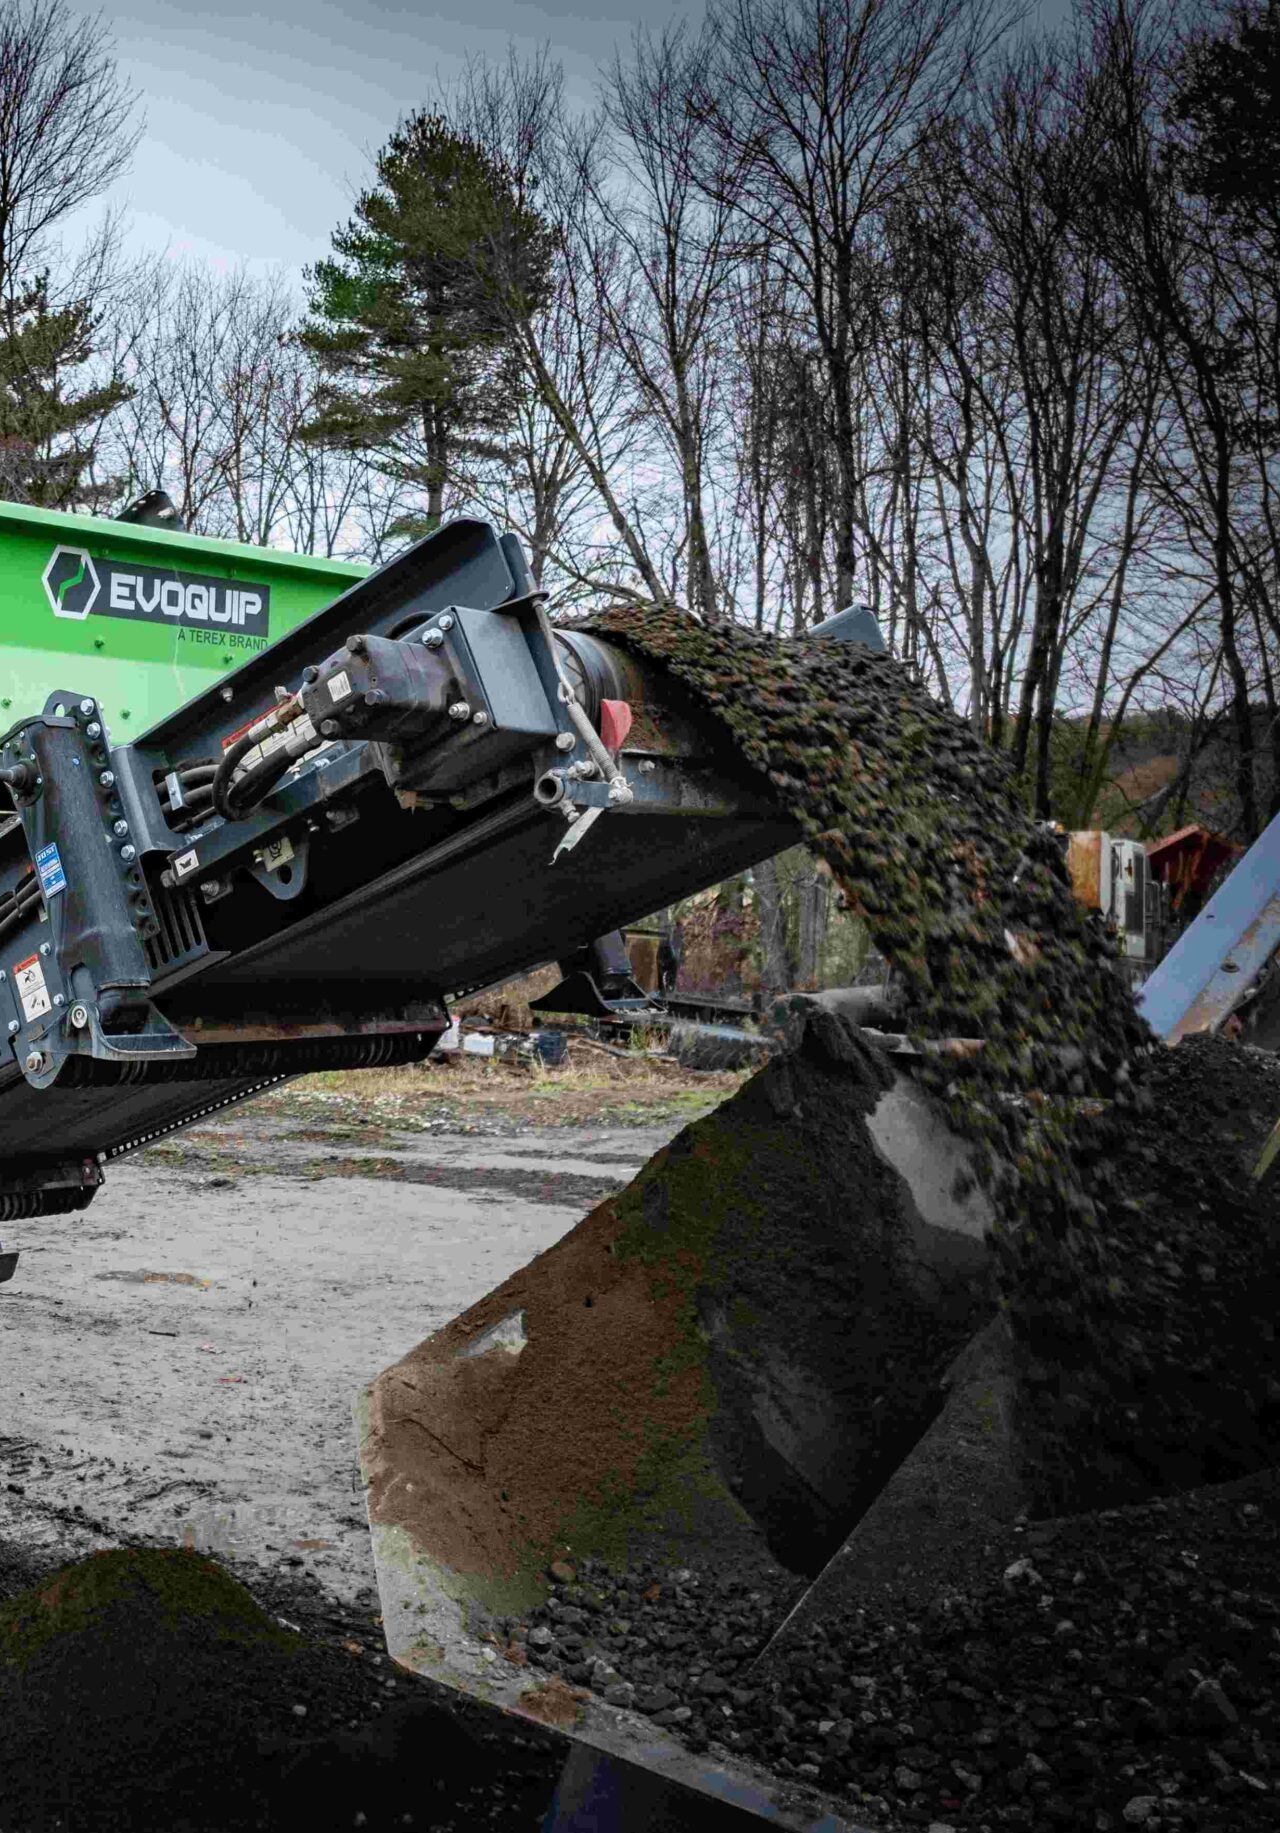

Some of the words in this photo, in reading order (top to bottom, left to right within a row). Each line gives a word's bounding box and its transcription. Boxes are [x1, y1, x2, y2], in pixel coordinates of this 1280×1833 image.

[110, 572, 261, 625] EVOQUIP
[178, 628, 186, 641] A
[189, 629, 227, 646] TEREX
[229, 634, 268, 651] BRAND
